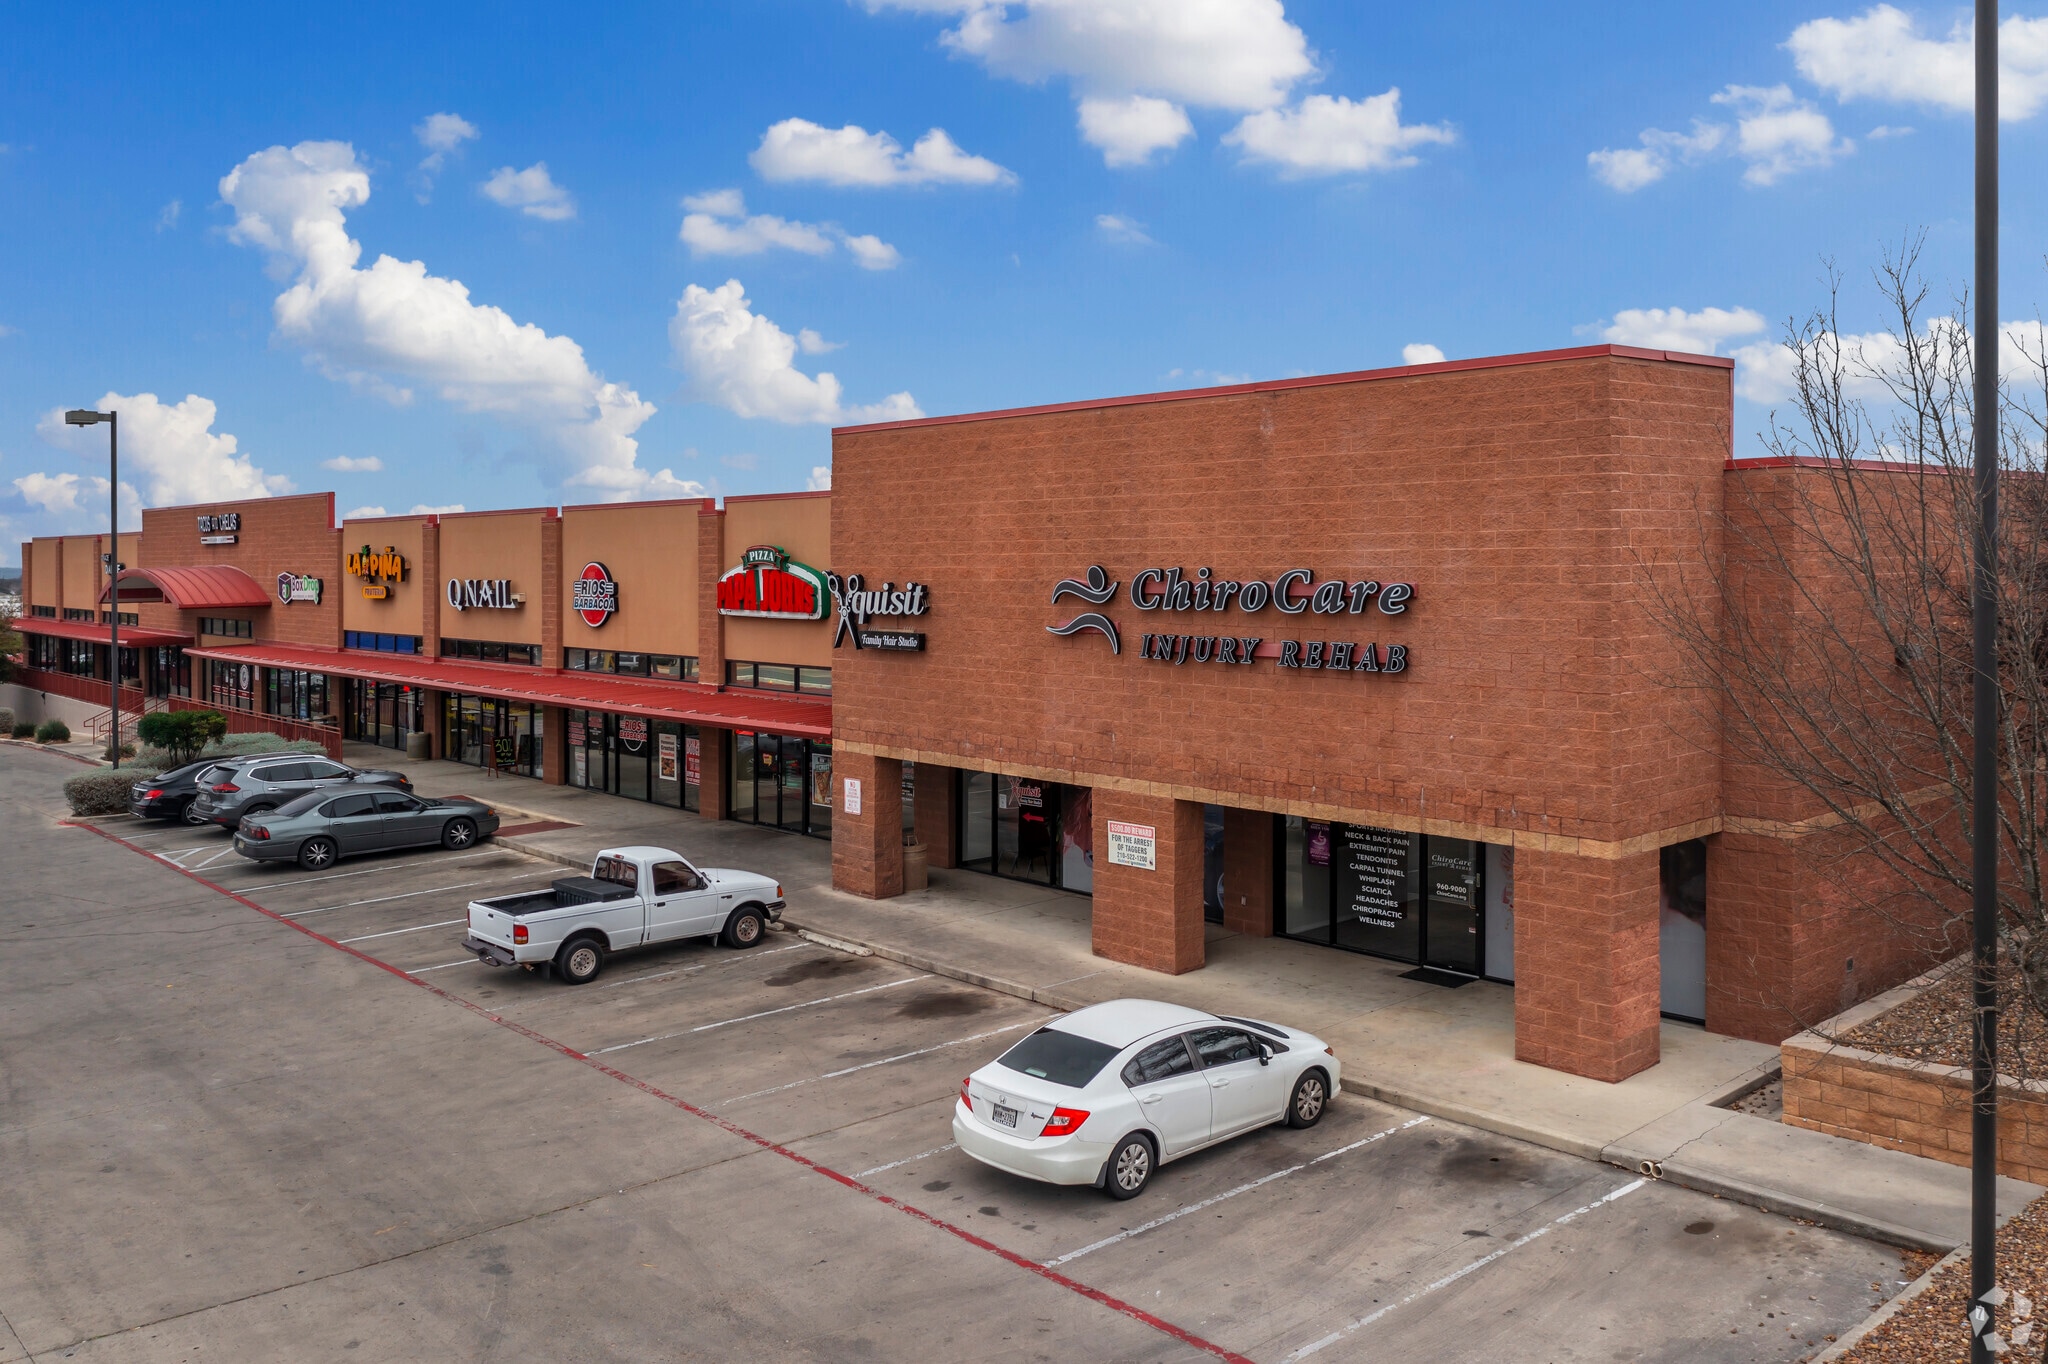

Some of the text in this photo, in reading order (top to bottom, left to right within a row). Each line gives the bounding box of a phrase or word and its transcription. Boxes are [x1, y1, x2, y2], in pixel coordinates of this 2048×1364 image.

[749, 550, 774, 562] PIZZA
[346, 546, 401, 583] LA PIÑA
[291, 575, 319, 603] BoxDrop
[447, 578, 464, 611] Q
[581, 580, 606, 596] RIOS
[717, 569, 757, 611] PAPA
[1130, 567, 1412, 614] ChiroCare
[573, 597, 615, 610] BARBACOA
[861, 633, 918, 649] Family Hair Studio
[1140, 634, 1409, 673] INJURY REHAB
[624, 720, 642, 732] RIOS
[1131, 826, 1153, 837] REWARD
[1345, 831, 1364, 840] NECK
[1372, 835, 1391, 844] BACK
[1393, 838, 1410, 847] PAIN
[1111, 833, 1153, 848] FOR THE ARREST
[1117, 843, 1148, 856] OF TAGGERS
[1349, 842, 1406, 857] EXTREMITY PAIN
[1356, 853, 1398, 866] TENDONITIS
[1431, 854, 1472, 867] ChiroCare
[1349, 862, 1405, 878] CARPAL TUNNEL
[1358, 874, 1395, 886] WHIPLASH
[1361, 885, 1393, 897] SCIATICA
[1436, 882, 1467, 894] 960-9000
[1355, 894, 1399, 908] HEADACHES
[1351, 904, 1403, 919] CHIROPRACTIC
[1358, 915, 1395, 928] WELLNESS
